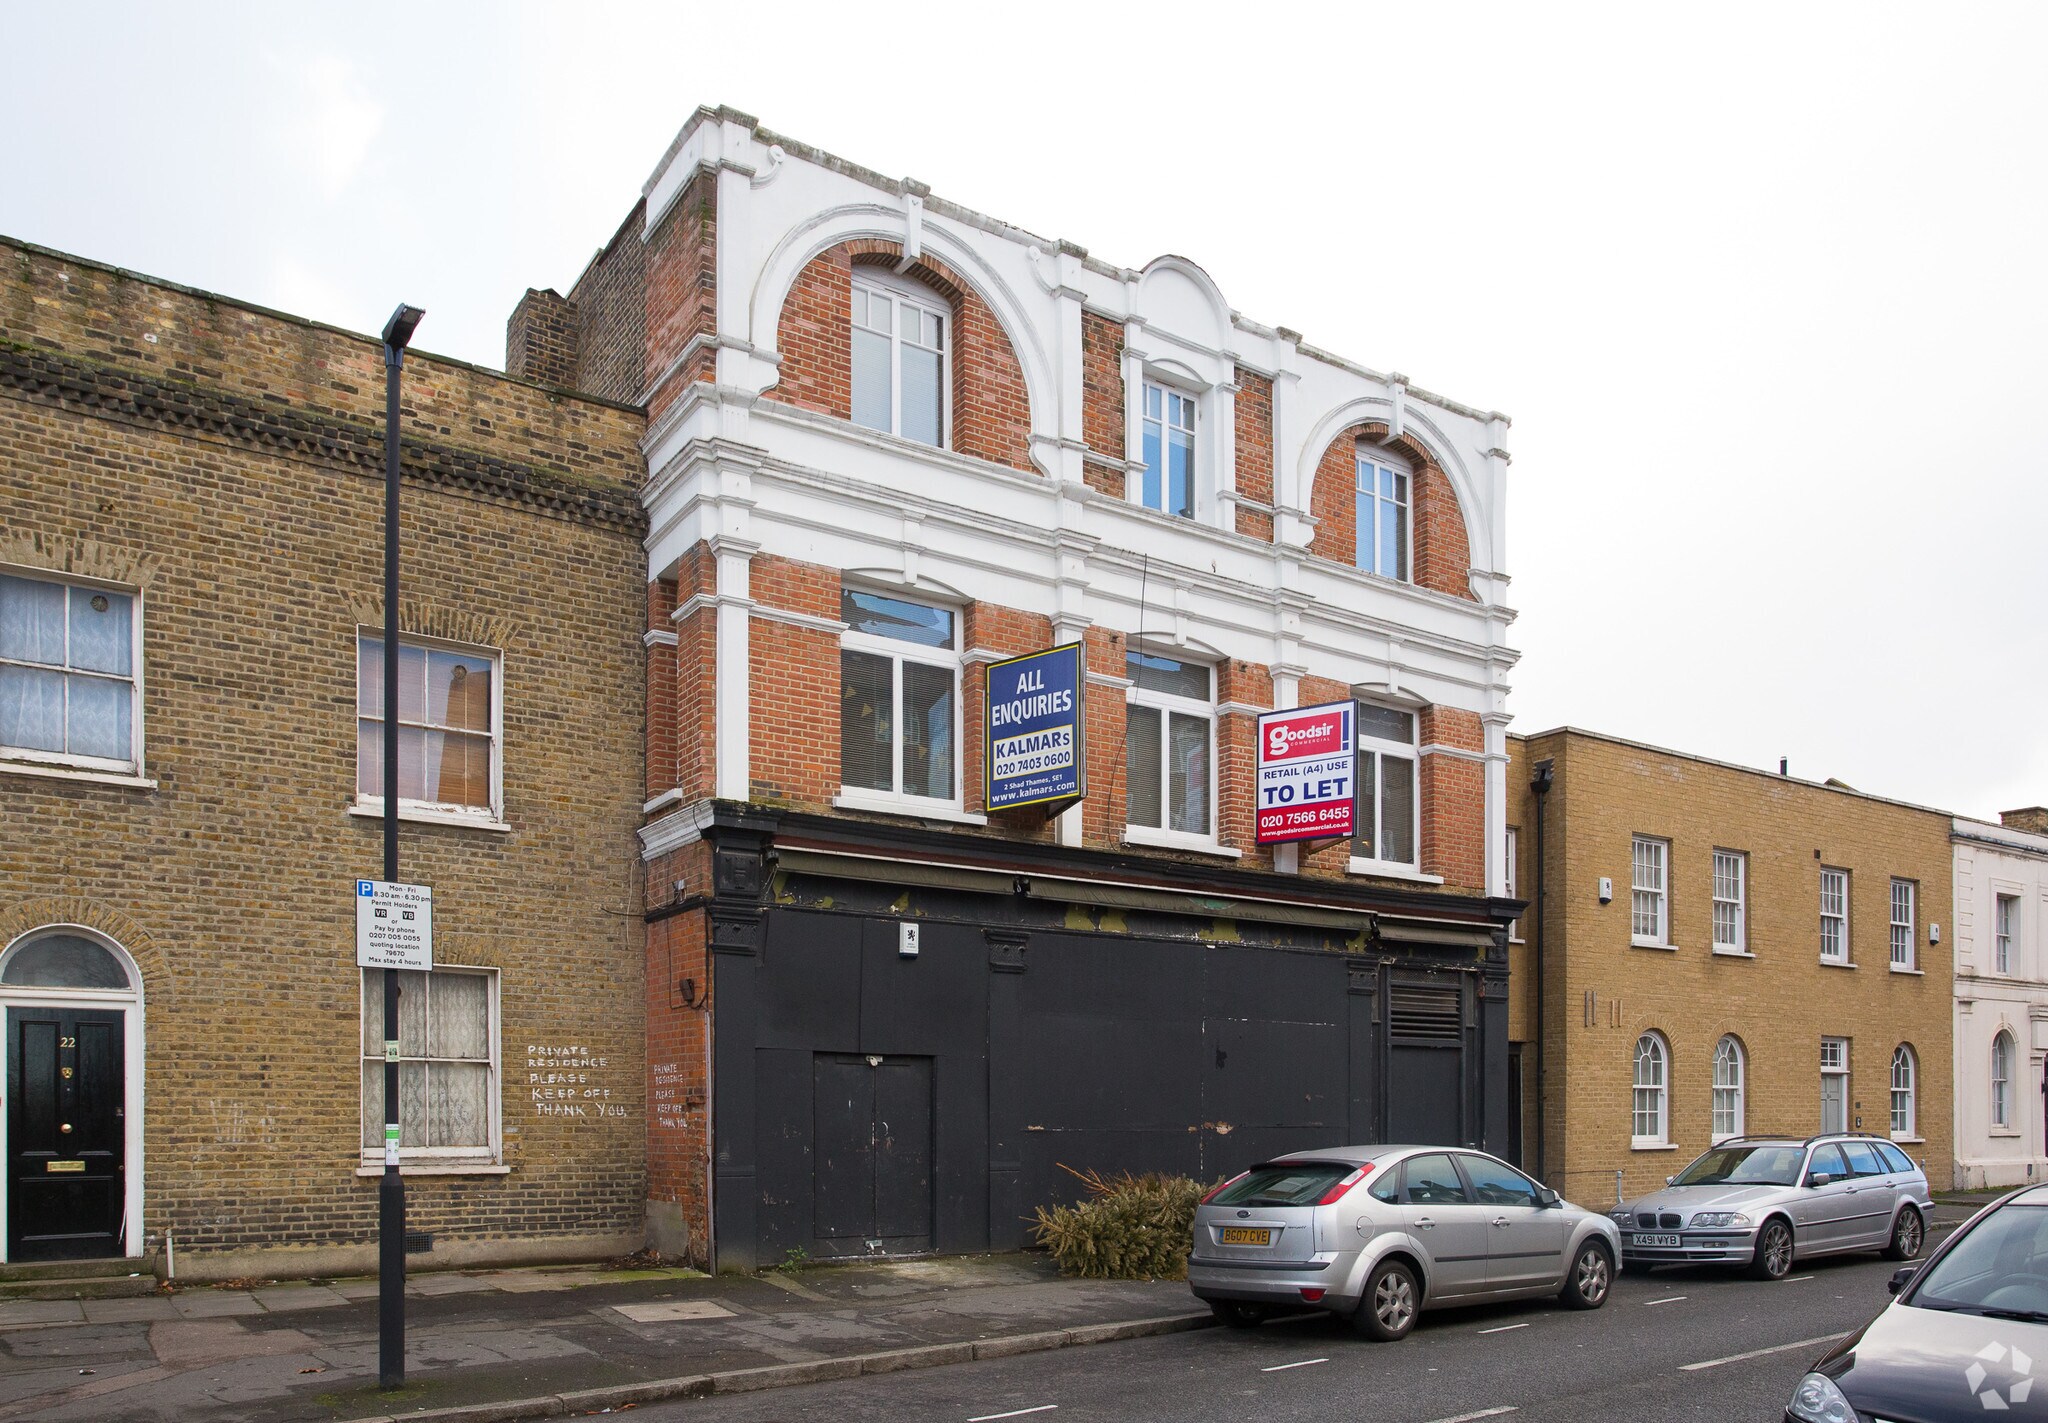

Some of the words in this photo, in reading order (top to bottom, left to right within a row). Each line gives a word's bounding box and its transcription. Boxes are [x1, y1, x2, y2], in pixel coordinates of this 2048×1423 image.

[1017, 669, 1045, 694] ALL
[992, 689, 1072, 726] ENQUIRIES
[1270, 722, 1334, 755] goodsir
[1290, 738, 1330, 746] COMMERCIAL
[997, 763, 1015, 775] 020
[1018, 757, 1041, 772] 7403
[1044, 751, 1070, 767] 0600
[1264, 768, 1299, 779] RETAIL
[1303, 764, 1323, 776] (A4)
[1327, 761, 1348, 771] USE
[1010, 780, 1024, 790] Shad
[1264, 784, 1294, 804] TO
[1304, 777, 1348, 799] LET
[992, 781, 1075, 802] www.kalmars.com
[1261, 815, 1283, 827] 020
[1287, 811, 1316, 825] 7566
[1320, 806, 1350, 819] 6455
[1262, 821, 1349, 837] www.goodsircommercial.co.uk
[362, 883, 370, 895] P
[372, 899, 392, 907] Permit
[375, 909, 387, 917] VR
[384, 957, 396, 965] stay
[60, 1037, 75, 1047] 22
[528, 1045, 588, 1056] PRIVATE
[528, 1058, 608, 1067] RESIDENCE
[654, 1064, 677, 1074] PRIVATE
[530, 1073, 587, 1084] PLEASE
[532, 1088, 575, 1100] KEEP
[584, 1089, 610, 1099] OFF
[656, 1089, 675, 1099] PLEASE
[536, 1103, 587, 1116] THANK
[1225, 1229, 1248, 1241] BG07
[1250, 1231, 1266, 1241] CVE
[1636, 1236, 1656, 1244] X491
[1658, 1235, 1677, 1244] VYB
